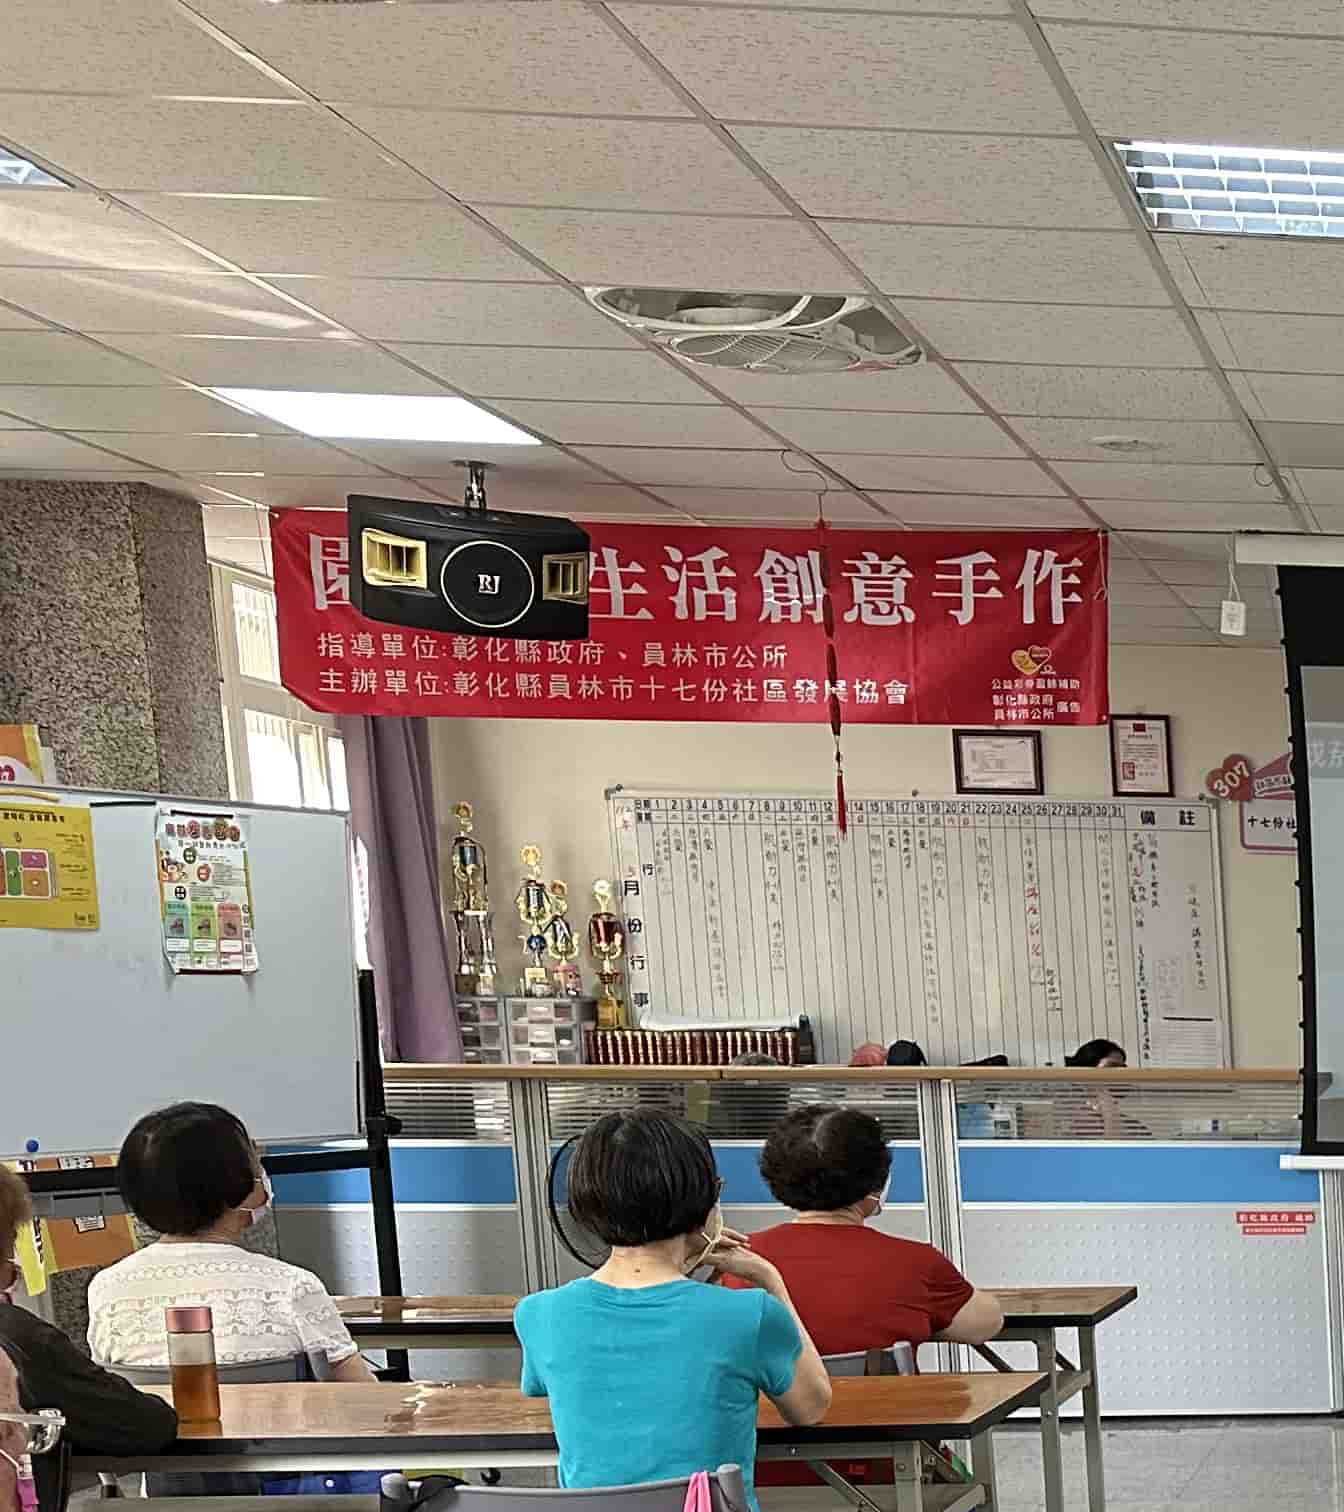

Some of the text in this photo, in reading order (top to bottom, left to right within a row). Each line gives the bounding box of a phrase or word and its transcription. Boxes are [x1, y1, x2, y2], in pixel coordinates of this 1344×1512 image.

[309, 533, 1082, 625] 生活創意手作
[477, 574, 501, 595] RJ
